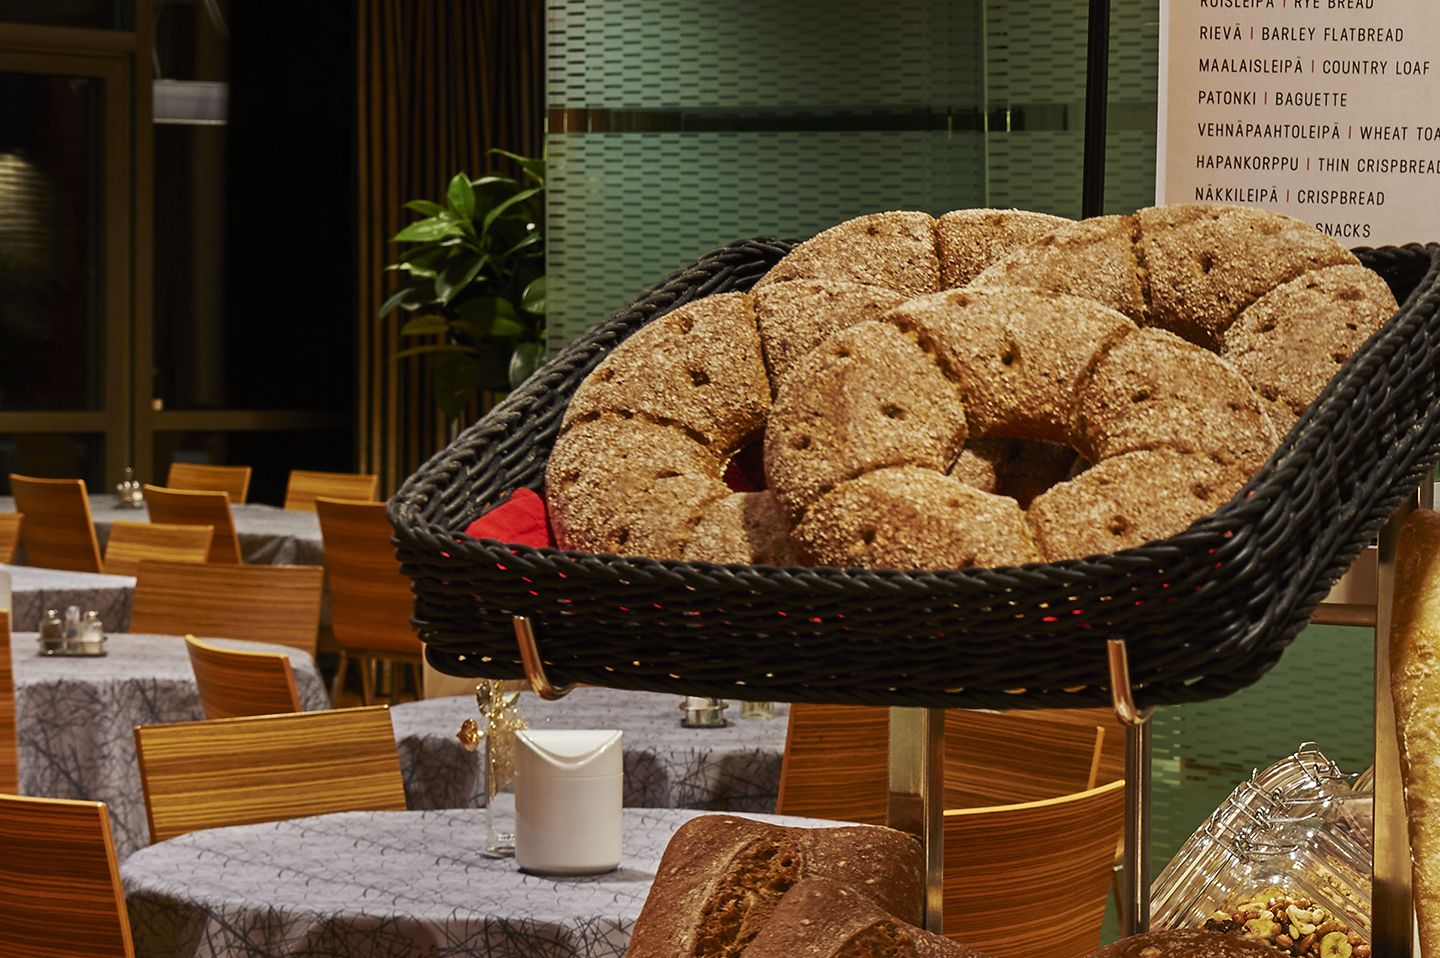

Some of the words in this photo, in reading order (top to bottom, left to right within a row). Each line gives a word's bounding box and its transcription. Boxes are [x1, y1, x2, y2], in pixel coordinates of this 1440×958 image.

[1200, 23, 1242, 40] RIEVÄ
[1262, 27, 1316, 41] BARLEY
[1324, 28, 1404, 42] FLATBREAD
[1199, 56, 1303, 73] MAALAISLEIPÄ
[1322, 60, 1388, 75] COUNTRY
[1396, 61, 1430, 75] LOAF
[1199, 90, 1256, 105] PATONKI
[1275, 92, 1347, 107] BAGUETTE
[1198, 120, 1340, 139] VEHNÄPAAHTOLEIPÄ
[1360, 126, 1408, 141] WHEAT
[1196, 155, 1299, 171] HAPANKORPPU
[1318, 157, 1349, 172] THIN
[1195, 184, 1278, 203] NÄKKILEIPÄ
[1297, 189, 1385, 206] CRISPBREAD
[1315, 222, 1371, 238] SNACKS
